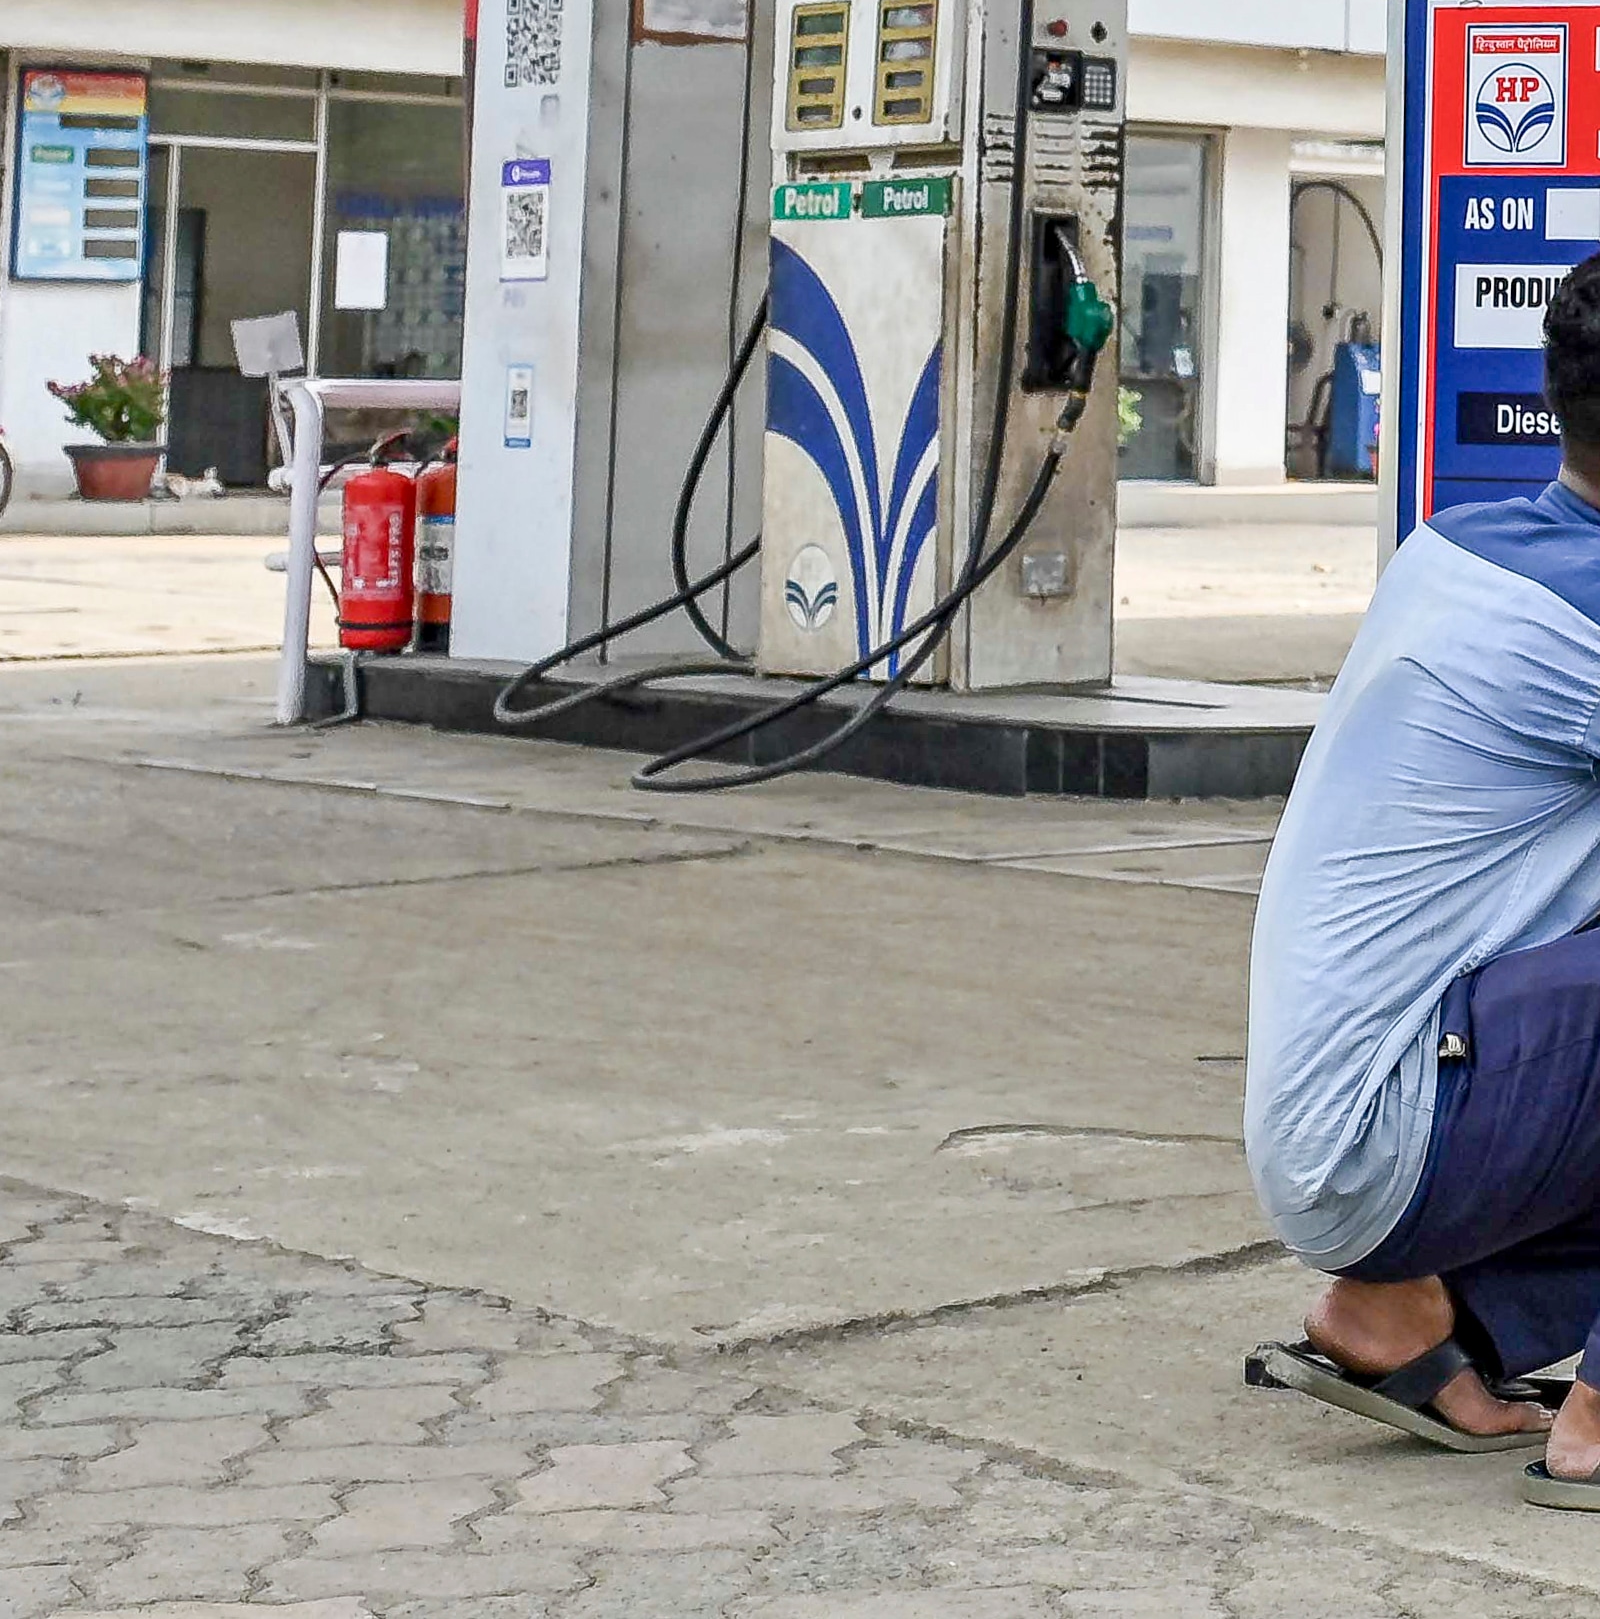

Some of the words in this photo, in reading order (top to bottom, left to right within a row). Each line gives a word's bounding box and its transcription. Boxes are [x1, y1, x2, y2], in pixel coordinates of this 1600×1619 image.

[1495, 77, 1540, 102] HP
[783, 186, 840, 217] Petrol
[883, 184, 929, 211] Petrol
[1464, 198, 1496, 230] AS
[1502, 198, 1534, 230] ON
[1475, 276, 1564, 309] PRODU
[1496, 403, 1562, 435] Diese
